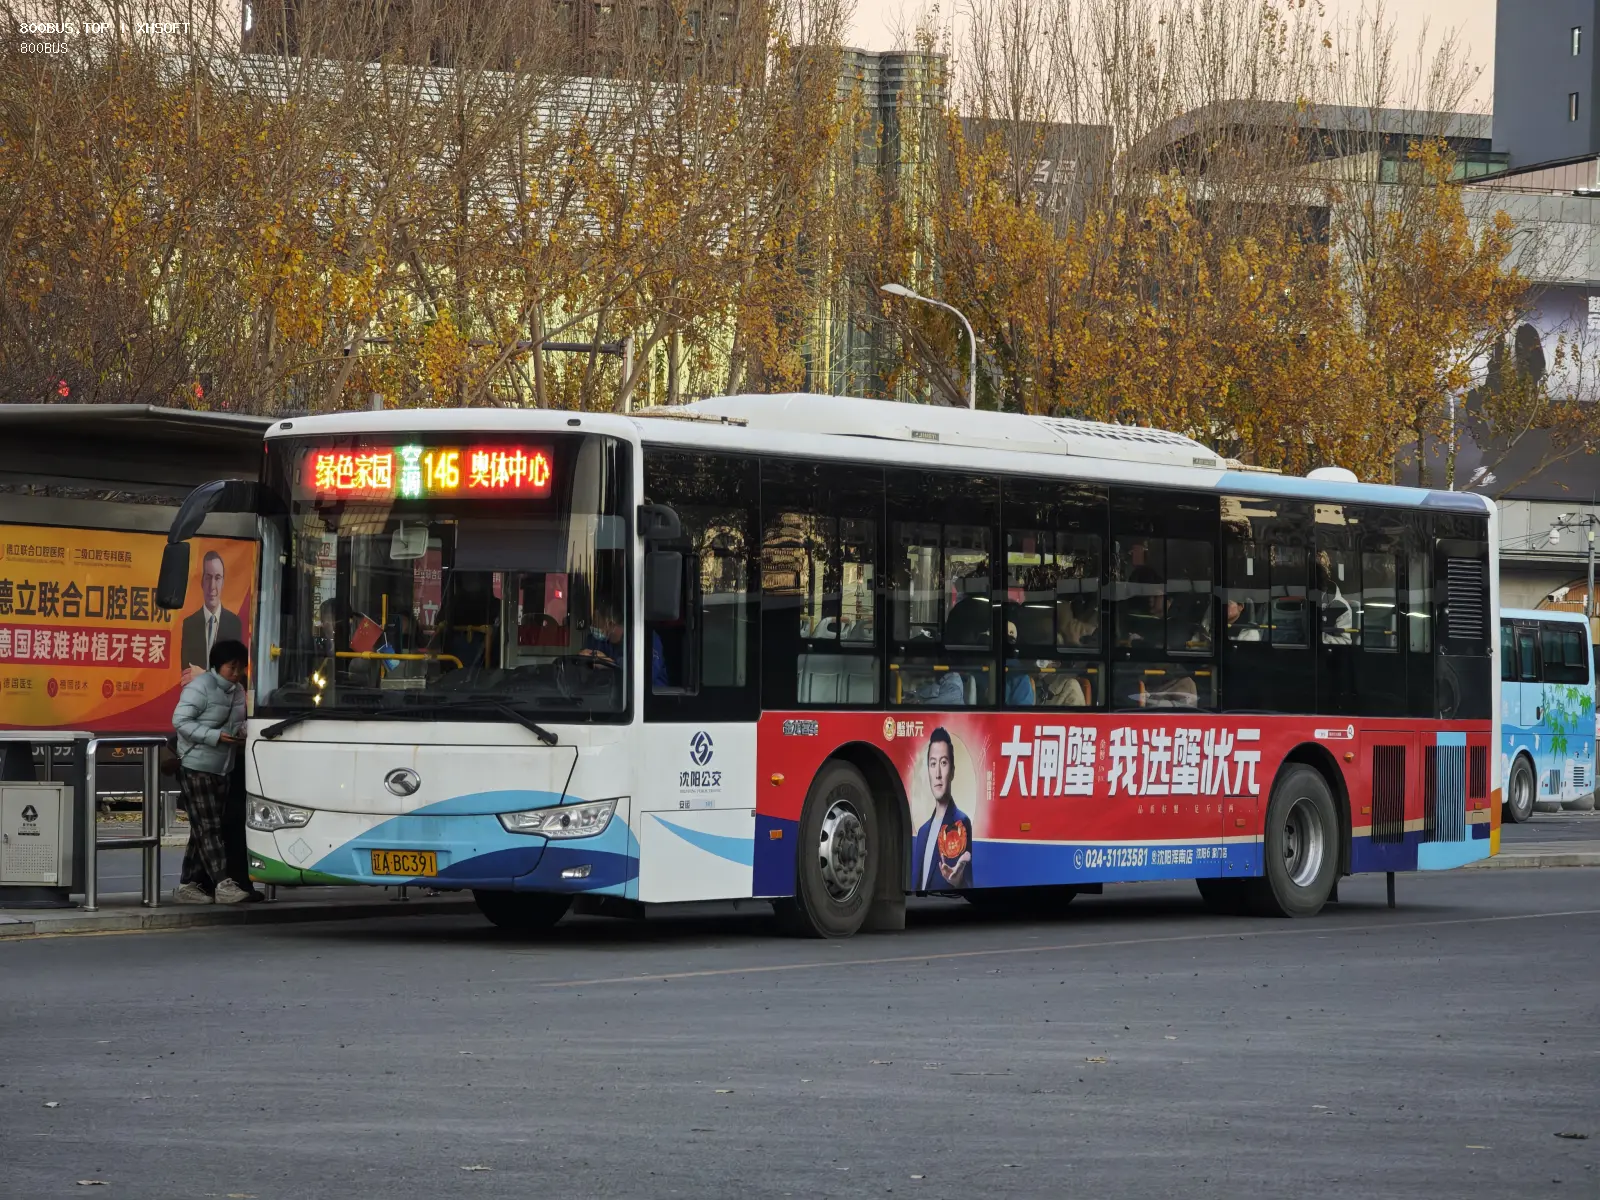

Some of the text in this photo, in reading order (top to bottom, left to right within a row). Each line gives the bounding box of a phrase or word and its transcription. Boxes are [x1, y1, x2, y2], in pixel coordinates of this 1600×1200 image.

[315, 453, 392, 489] 绿色家园
[424, 452, 460, 489] 146
[469, 450, 550, 489] 奥体中心
[7, 544, 65, 559] 德立联合口腔医院
[74, 548, 132, 562] 二级口腔专科医院
[679, 771, 722, 787] 沈阳公交
[1000, 725, 1097, 797] 大闸蟹
[1107, 727, 1261, 796] 我选蟹状元
[1085, 848, 1149, 868] 024-31123581
